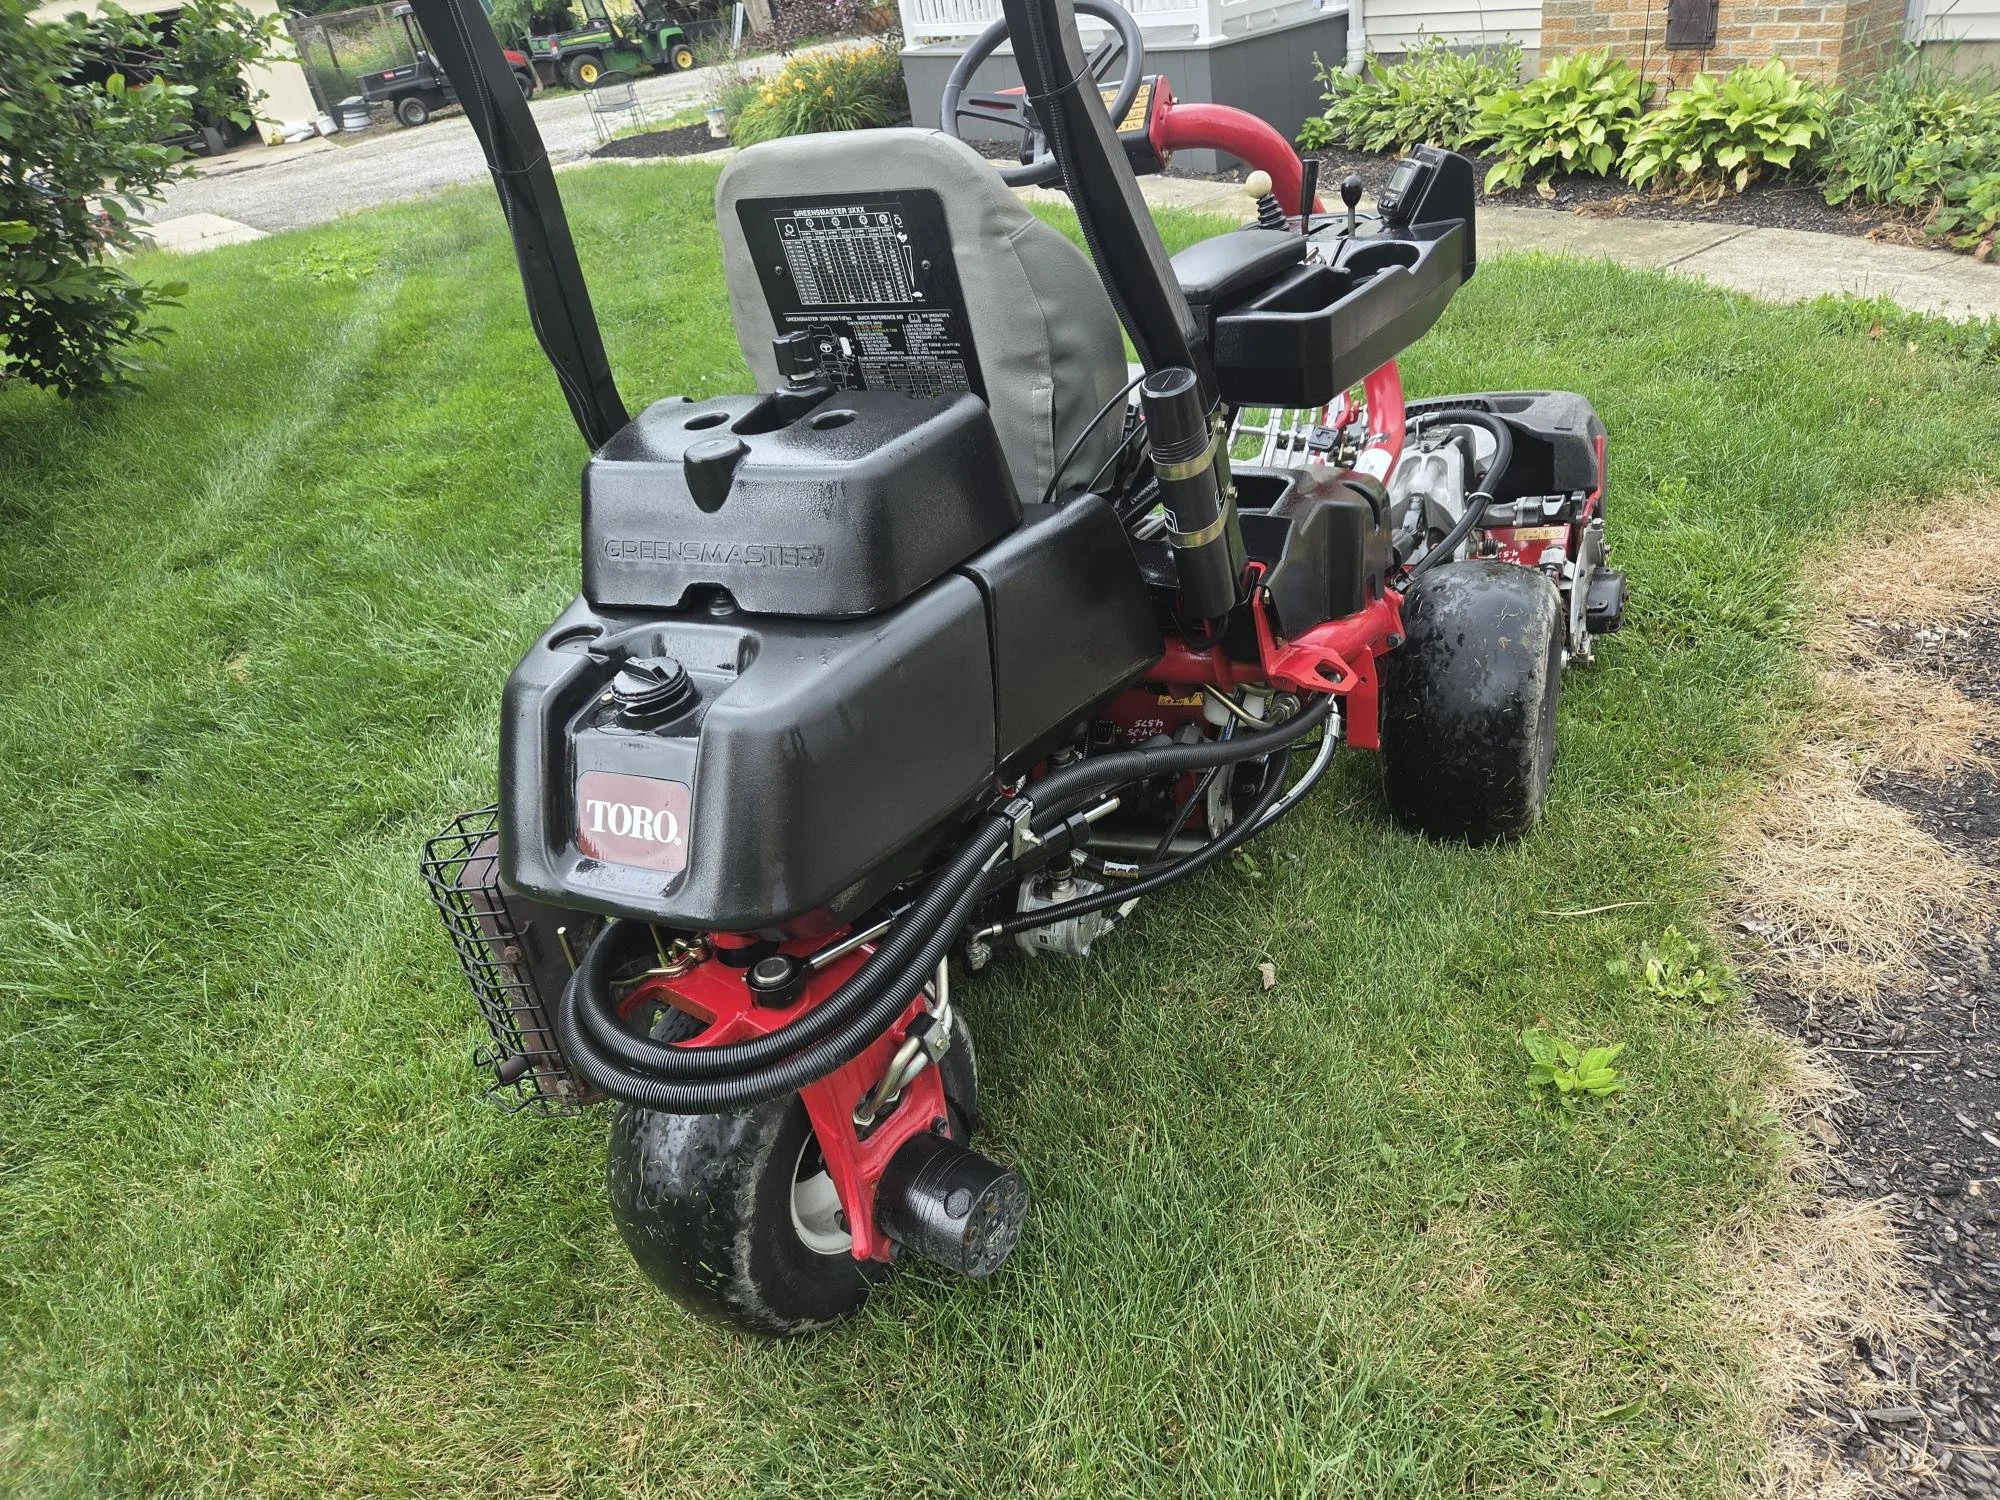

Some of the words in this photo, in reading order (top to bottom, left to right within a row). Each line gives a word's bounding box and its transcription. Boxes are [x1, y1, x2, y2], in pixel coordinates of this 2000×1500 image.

[793, 208, 847, 217] GREENSMASTER
[847, 206, 865, 214] 3XXX
[604, 539, 824, 569] GREENSMASTER
[586, 799, 679, 844] TORO
